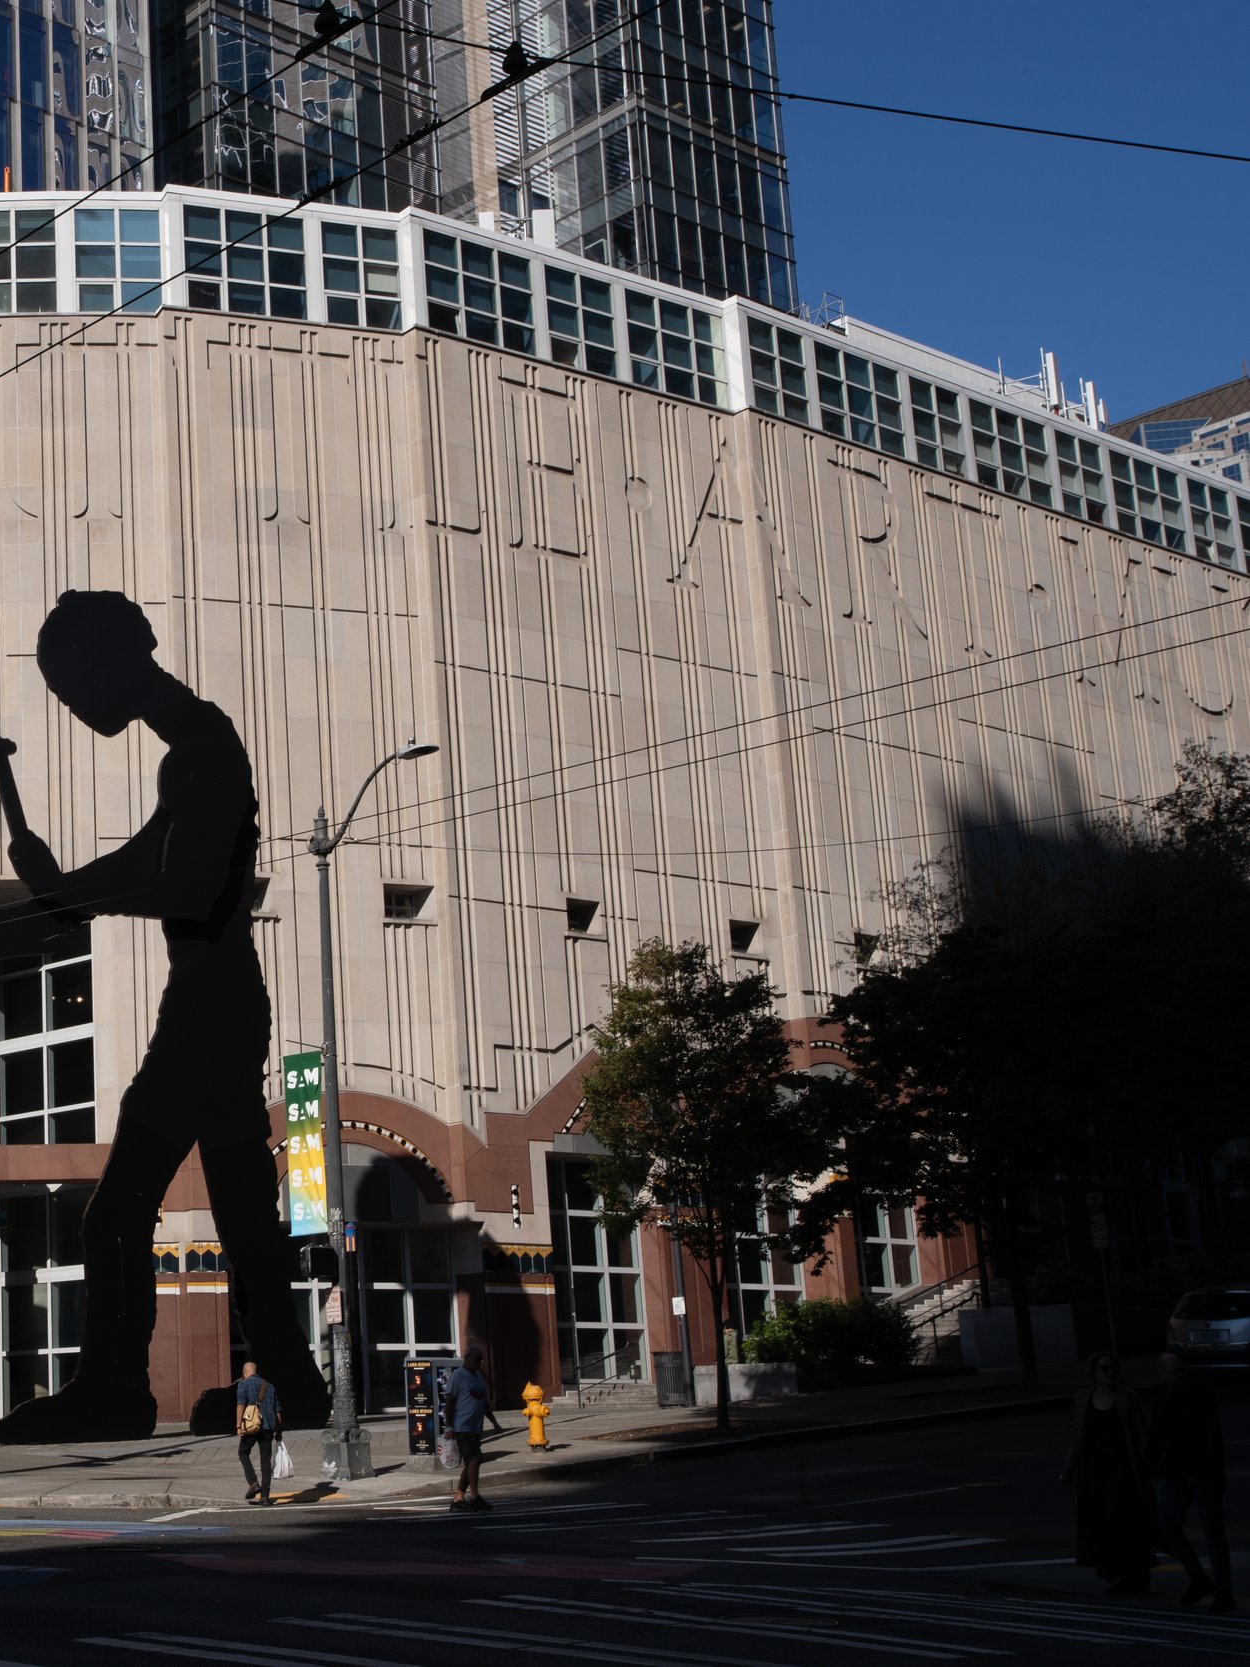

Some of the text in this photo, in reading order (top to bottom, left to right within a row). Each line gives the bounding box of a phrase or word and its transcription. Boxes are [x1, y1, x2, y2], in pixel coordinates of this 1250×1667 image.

[666, 432, 1001, 658] ART
[286, 1067, 320, 1090] SAM
[288, 1099, 320, 1122] SAM
[290, 1132, 322, 1155] SAM
[291, 1166, 323, 1188] SAM
